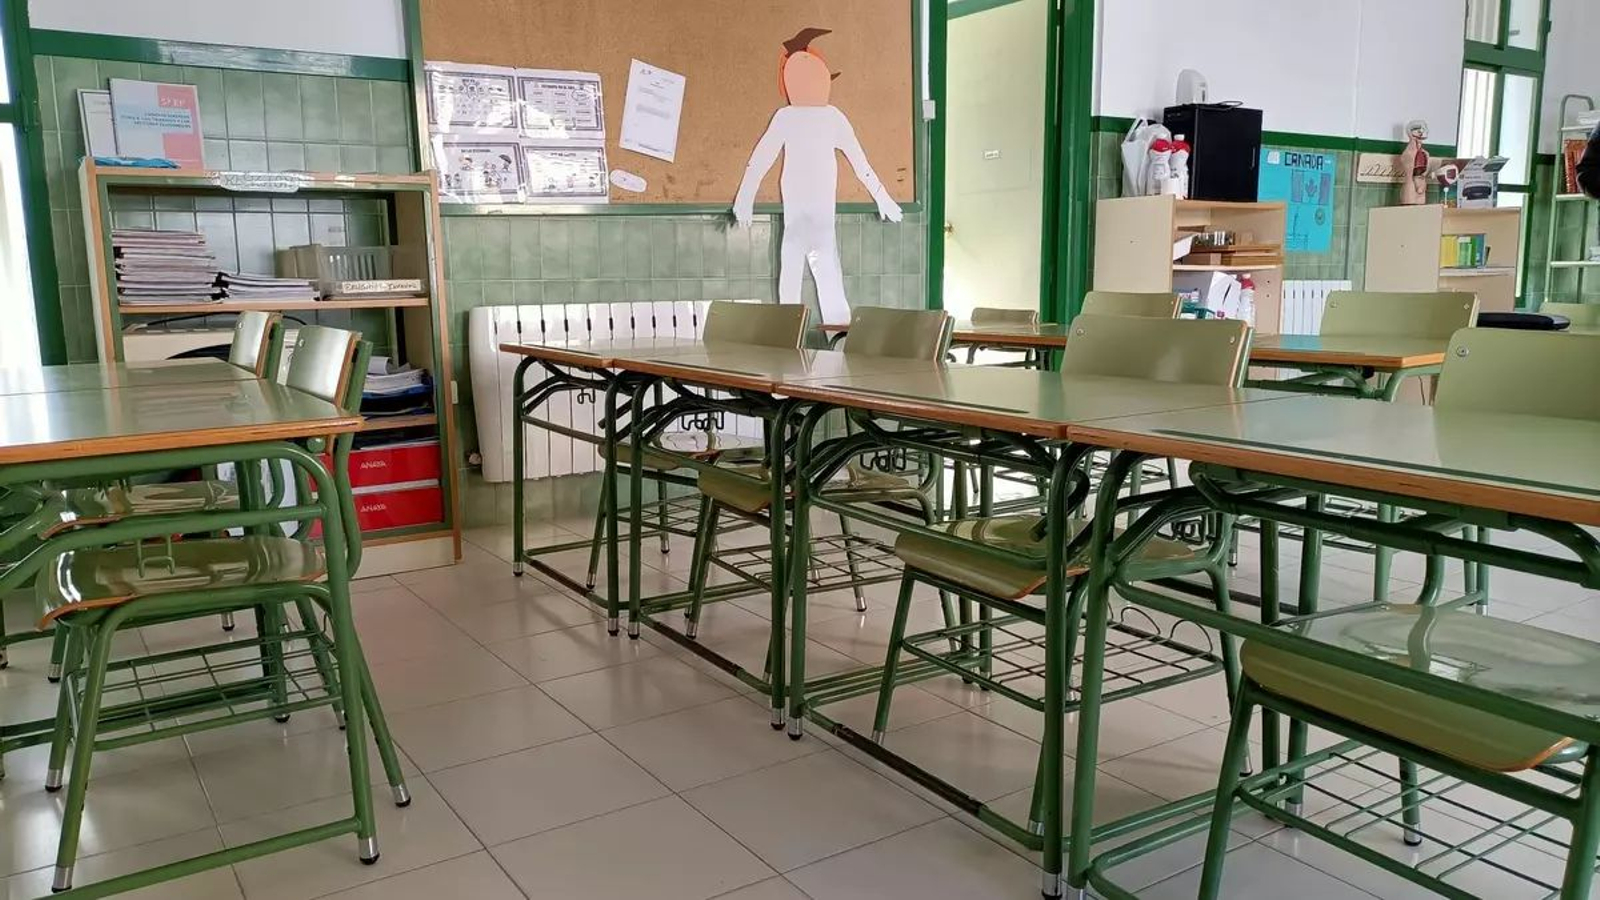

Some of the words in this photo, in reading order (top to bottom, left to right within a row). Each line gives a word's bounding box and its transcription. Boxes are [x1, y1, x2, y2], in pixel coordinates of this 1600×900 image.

[1284, 152, 1323, 170] CANADA
[360, 460, 386, 469] ANAYA
[360, 503, 386, 513] ANAYA
